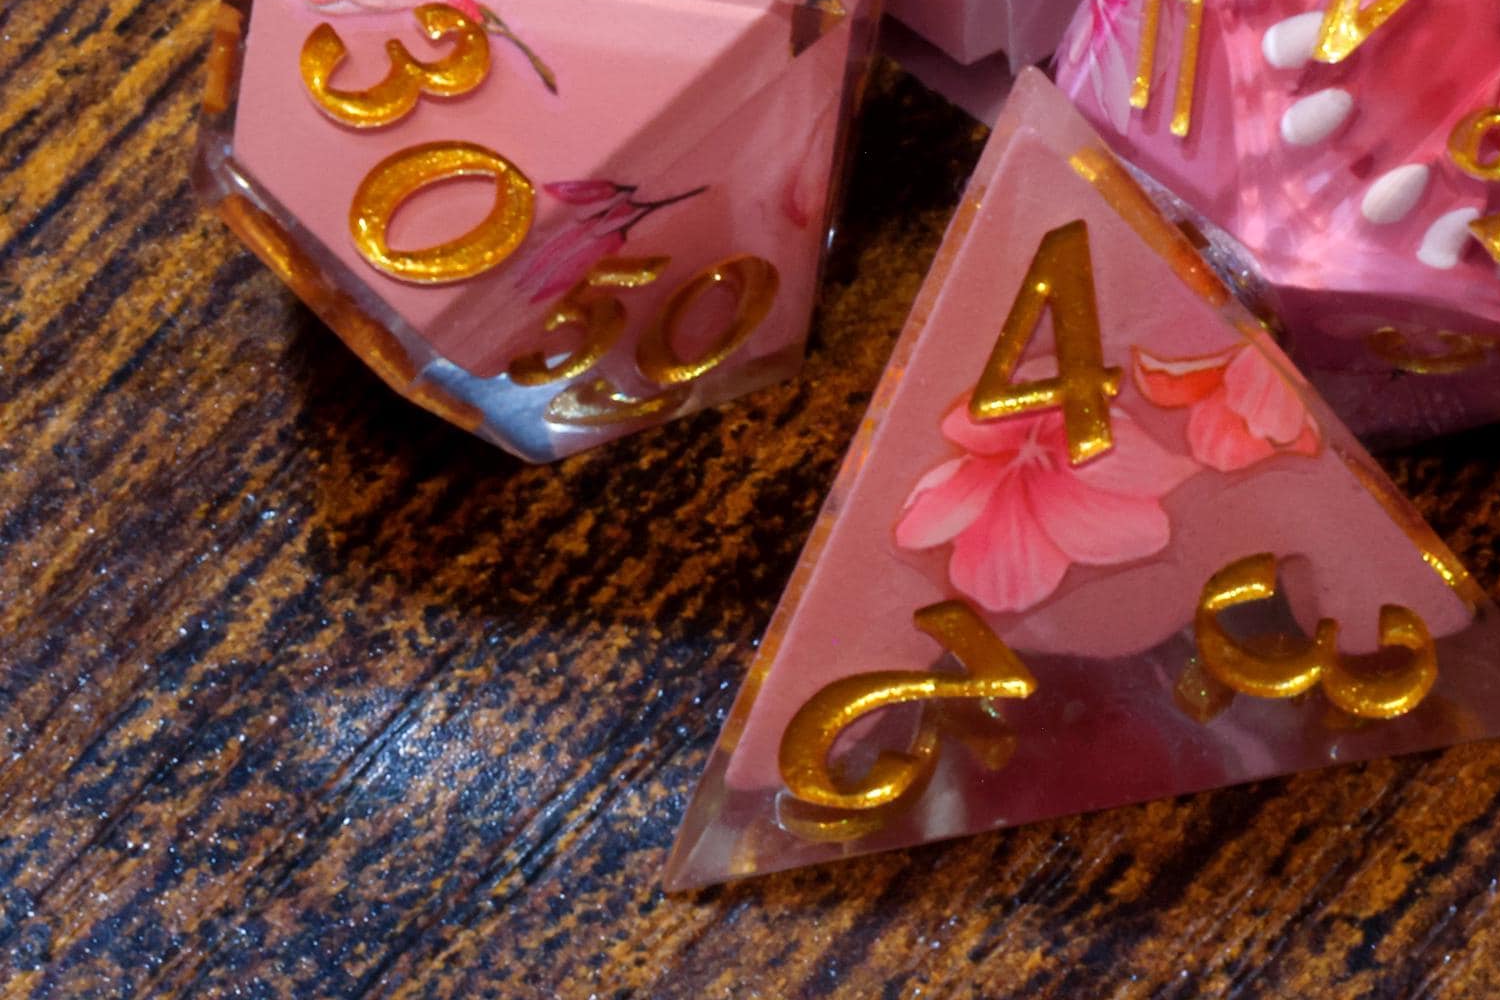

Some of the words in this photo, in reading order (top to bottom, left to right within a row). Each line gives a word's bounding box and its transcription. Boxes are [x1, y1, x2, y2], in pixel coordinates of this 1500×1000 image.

[302, 5, 532, 281] 30
[510, 257, 777, 384] 50
[973, 221, 1119, 463] 4
[780, 604, 1034, 807] 2
[1201, 555, 1435, 717] 3
